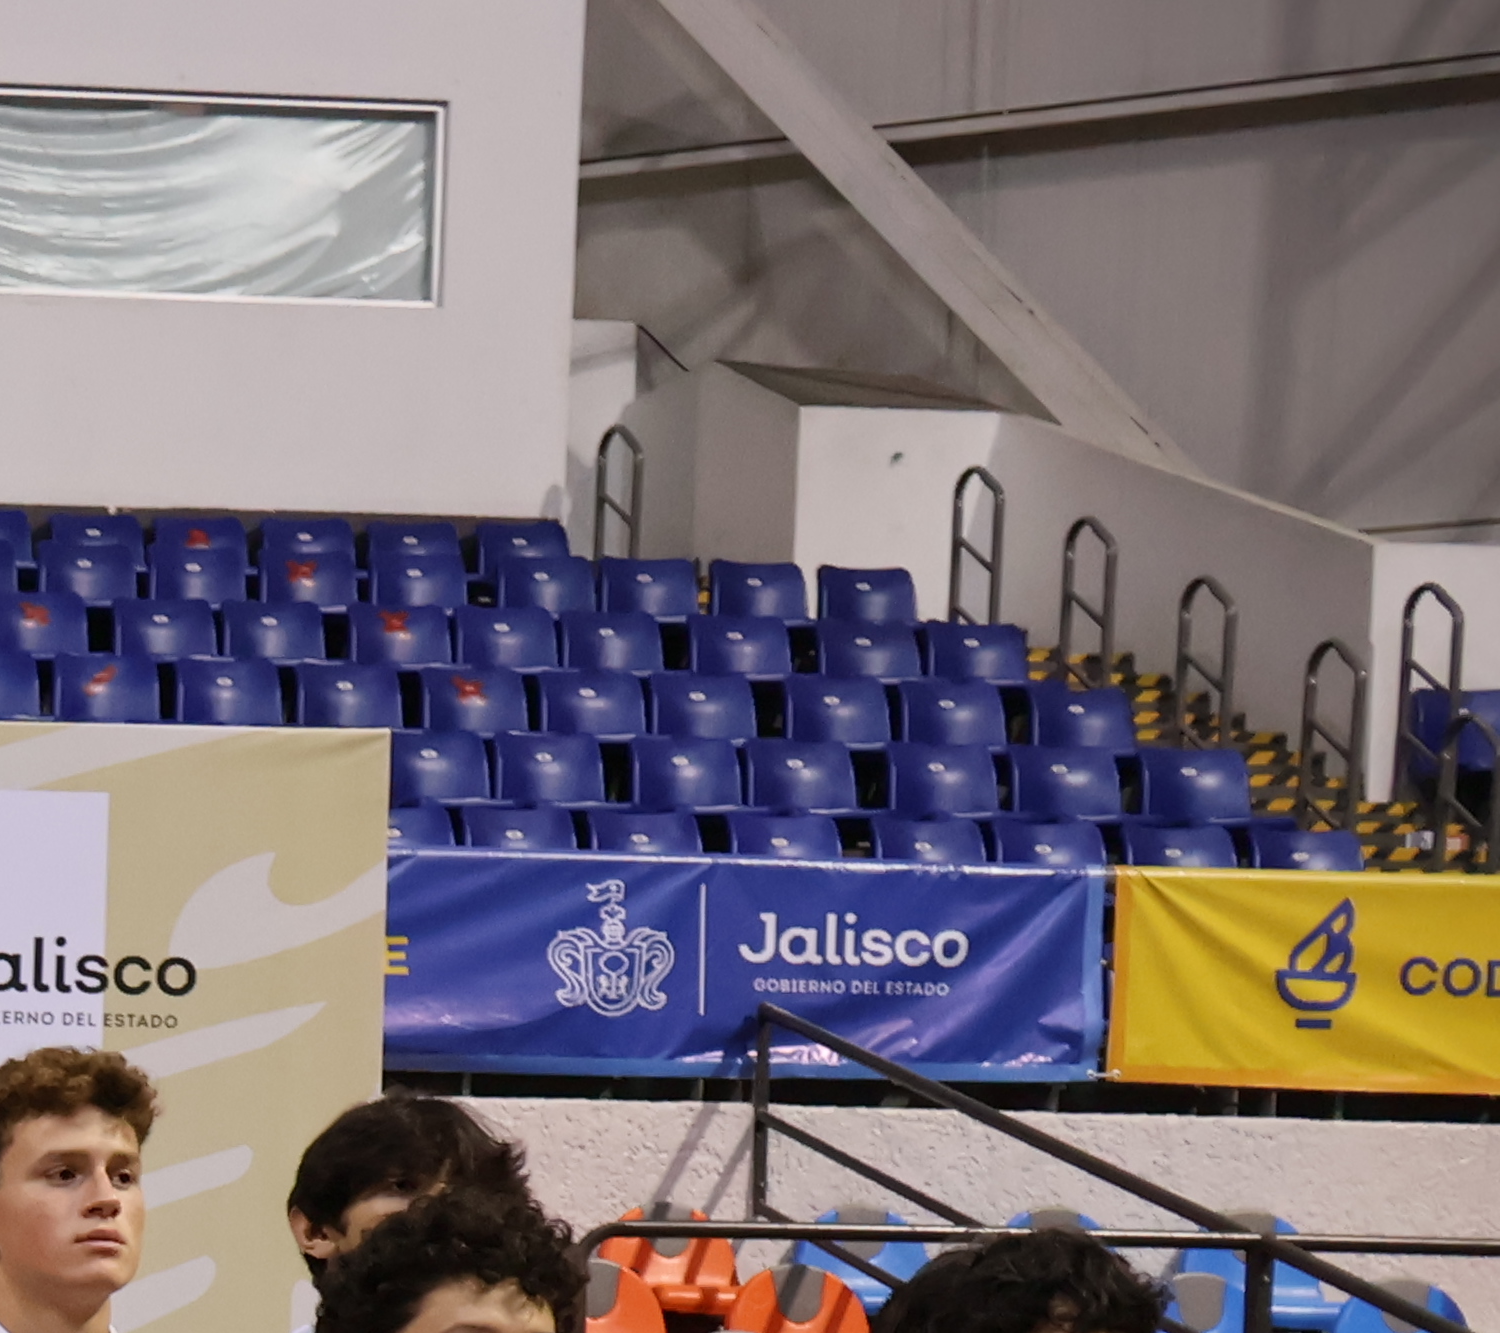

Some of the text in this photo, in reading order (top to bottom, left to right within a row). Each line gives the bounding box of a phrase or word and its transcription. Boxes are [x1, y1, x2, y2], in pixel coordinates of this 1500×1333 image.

[738, 912, 970, 968] Jalisco
[752, 976, 950, 998] GOBIERNO DEL ESTADO
[1399, 955, 1500, 1001] CO
[62, 1010, 97, 1027] DEL
[104, 1010, 179, 1030] ESTADO
